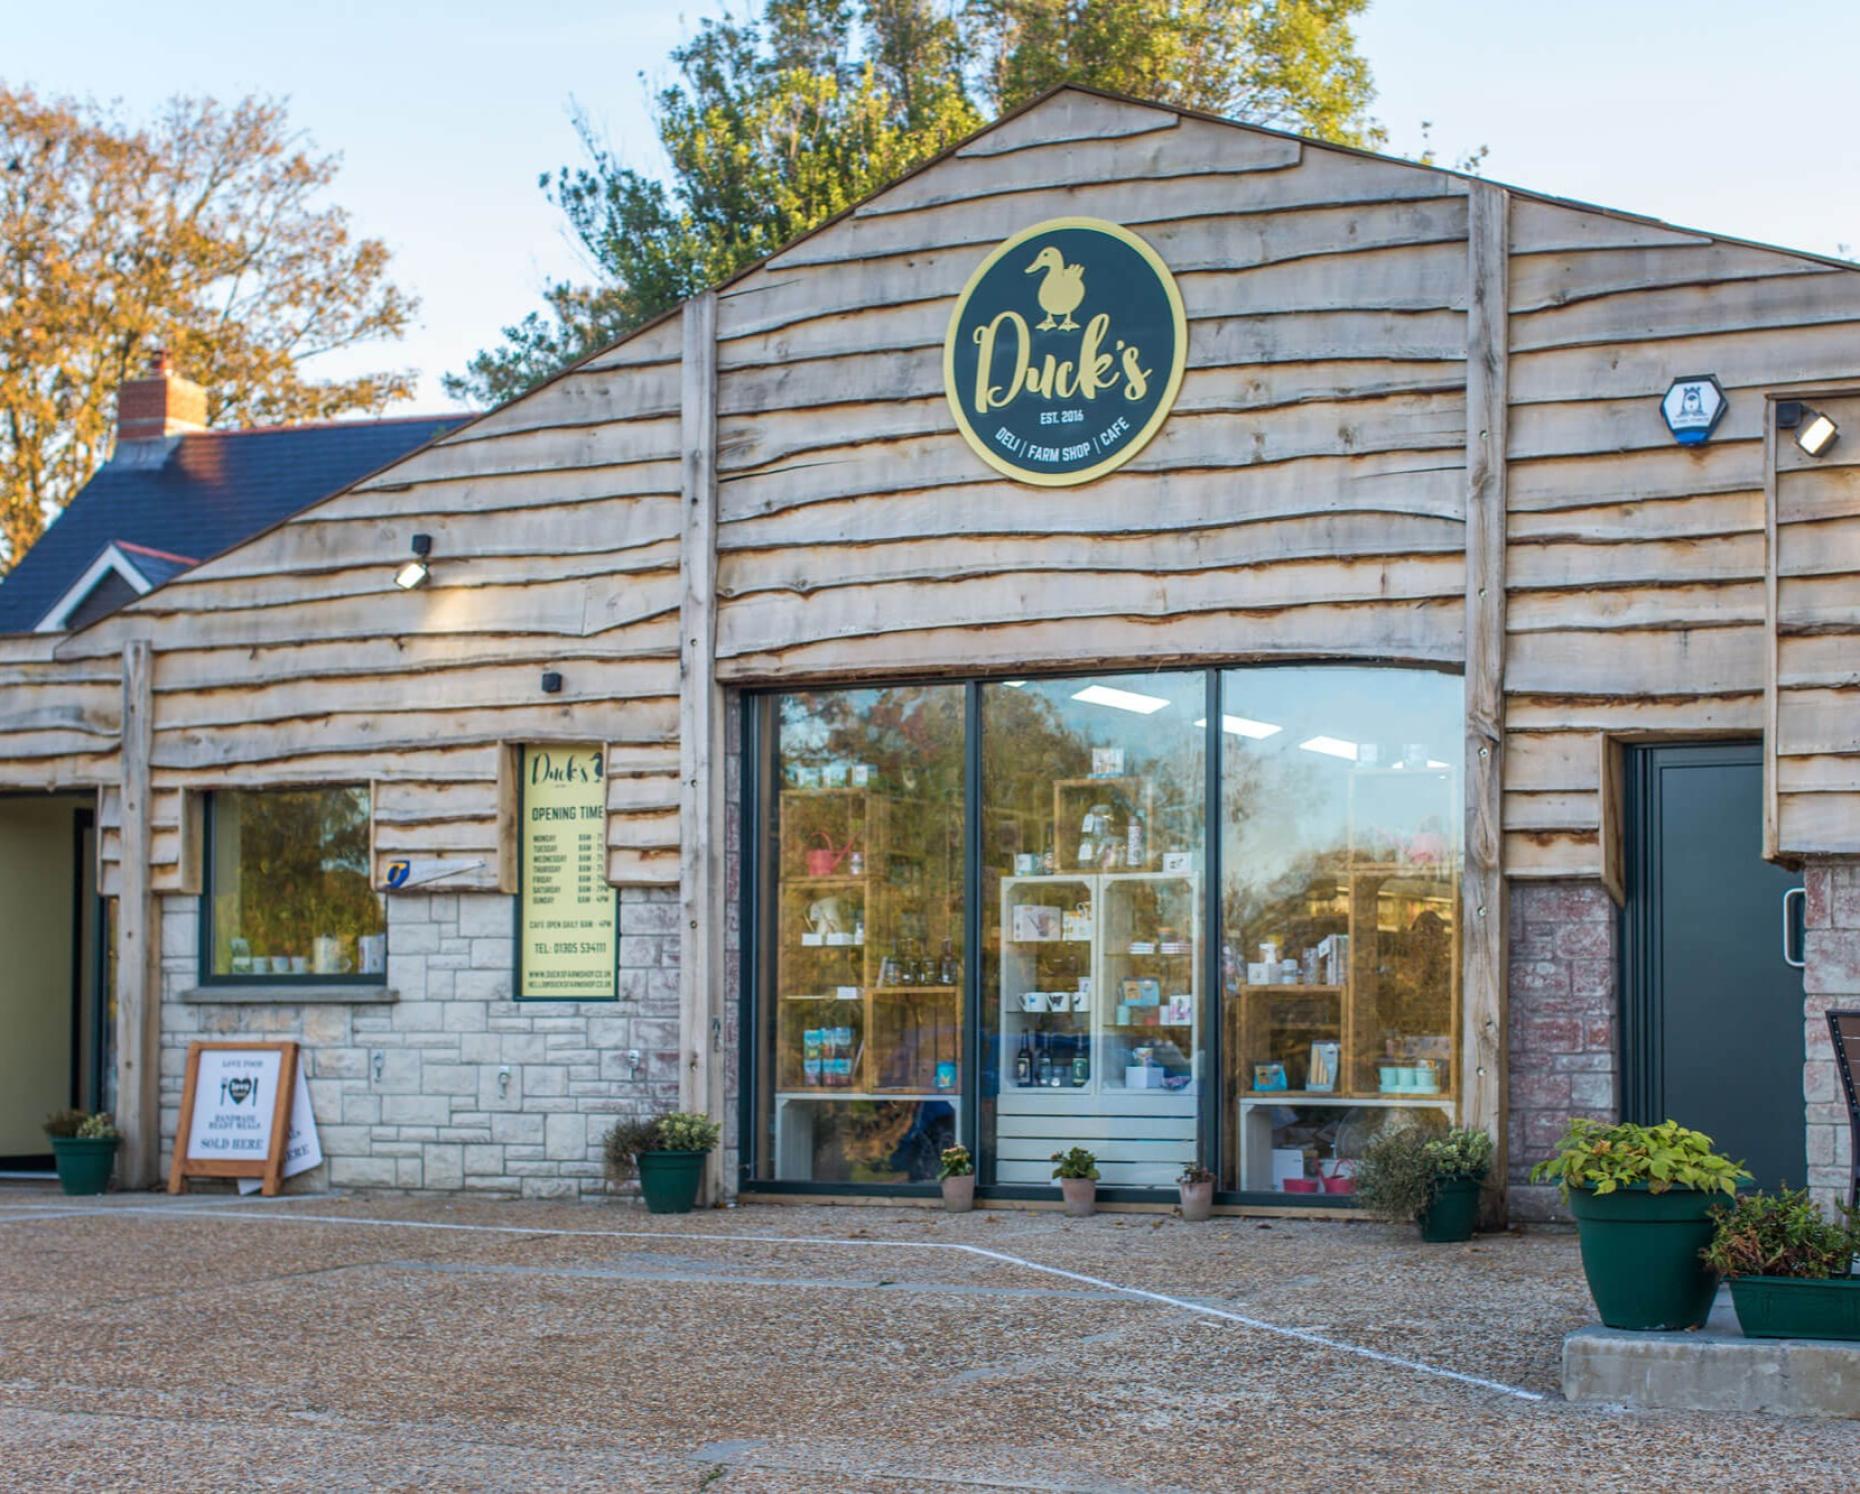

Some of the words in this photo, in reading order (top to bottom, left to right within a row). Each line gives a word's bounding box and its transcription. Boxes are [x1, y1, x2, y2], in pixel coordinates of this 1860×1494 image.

[973, 311, 1152, 414] Duck's
[1040, 411, 1060, 425] EST.
[1061, 409, 1084, 423] 2016
[994, 426, 1021, 452] DELI
[1027, 444, 1060, 463] FARM
[1062, 442, 1091, 462] SHOP
[1099, 416, 1130, 447] CAFE
[531, 806, 577, 821] OPENING
[579, 805, 604, 819] TIME
[553, 942, 577, 954] 01305
[200, 1138, 230, 1149] SOLD
[232, 1138, 264, 1150] HERE
[286, 1144, 310, 1161] ERE
